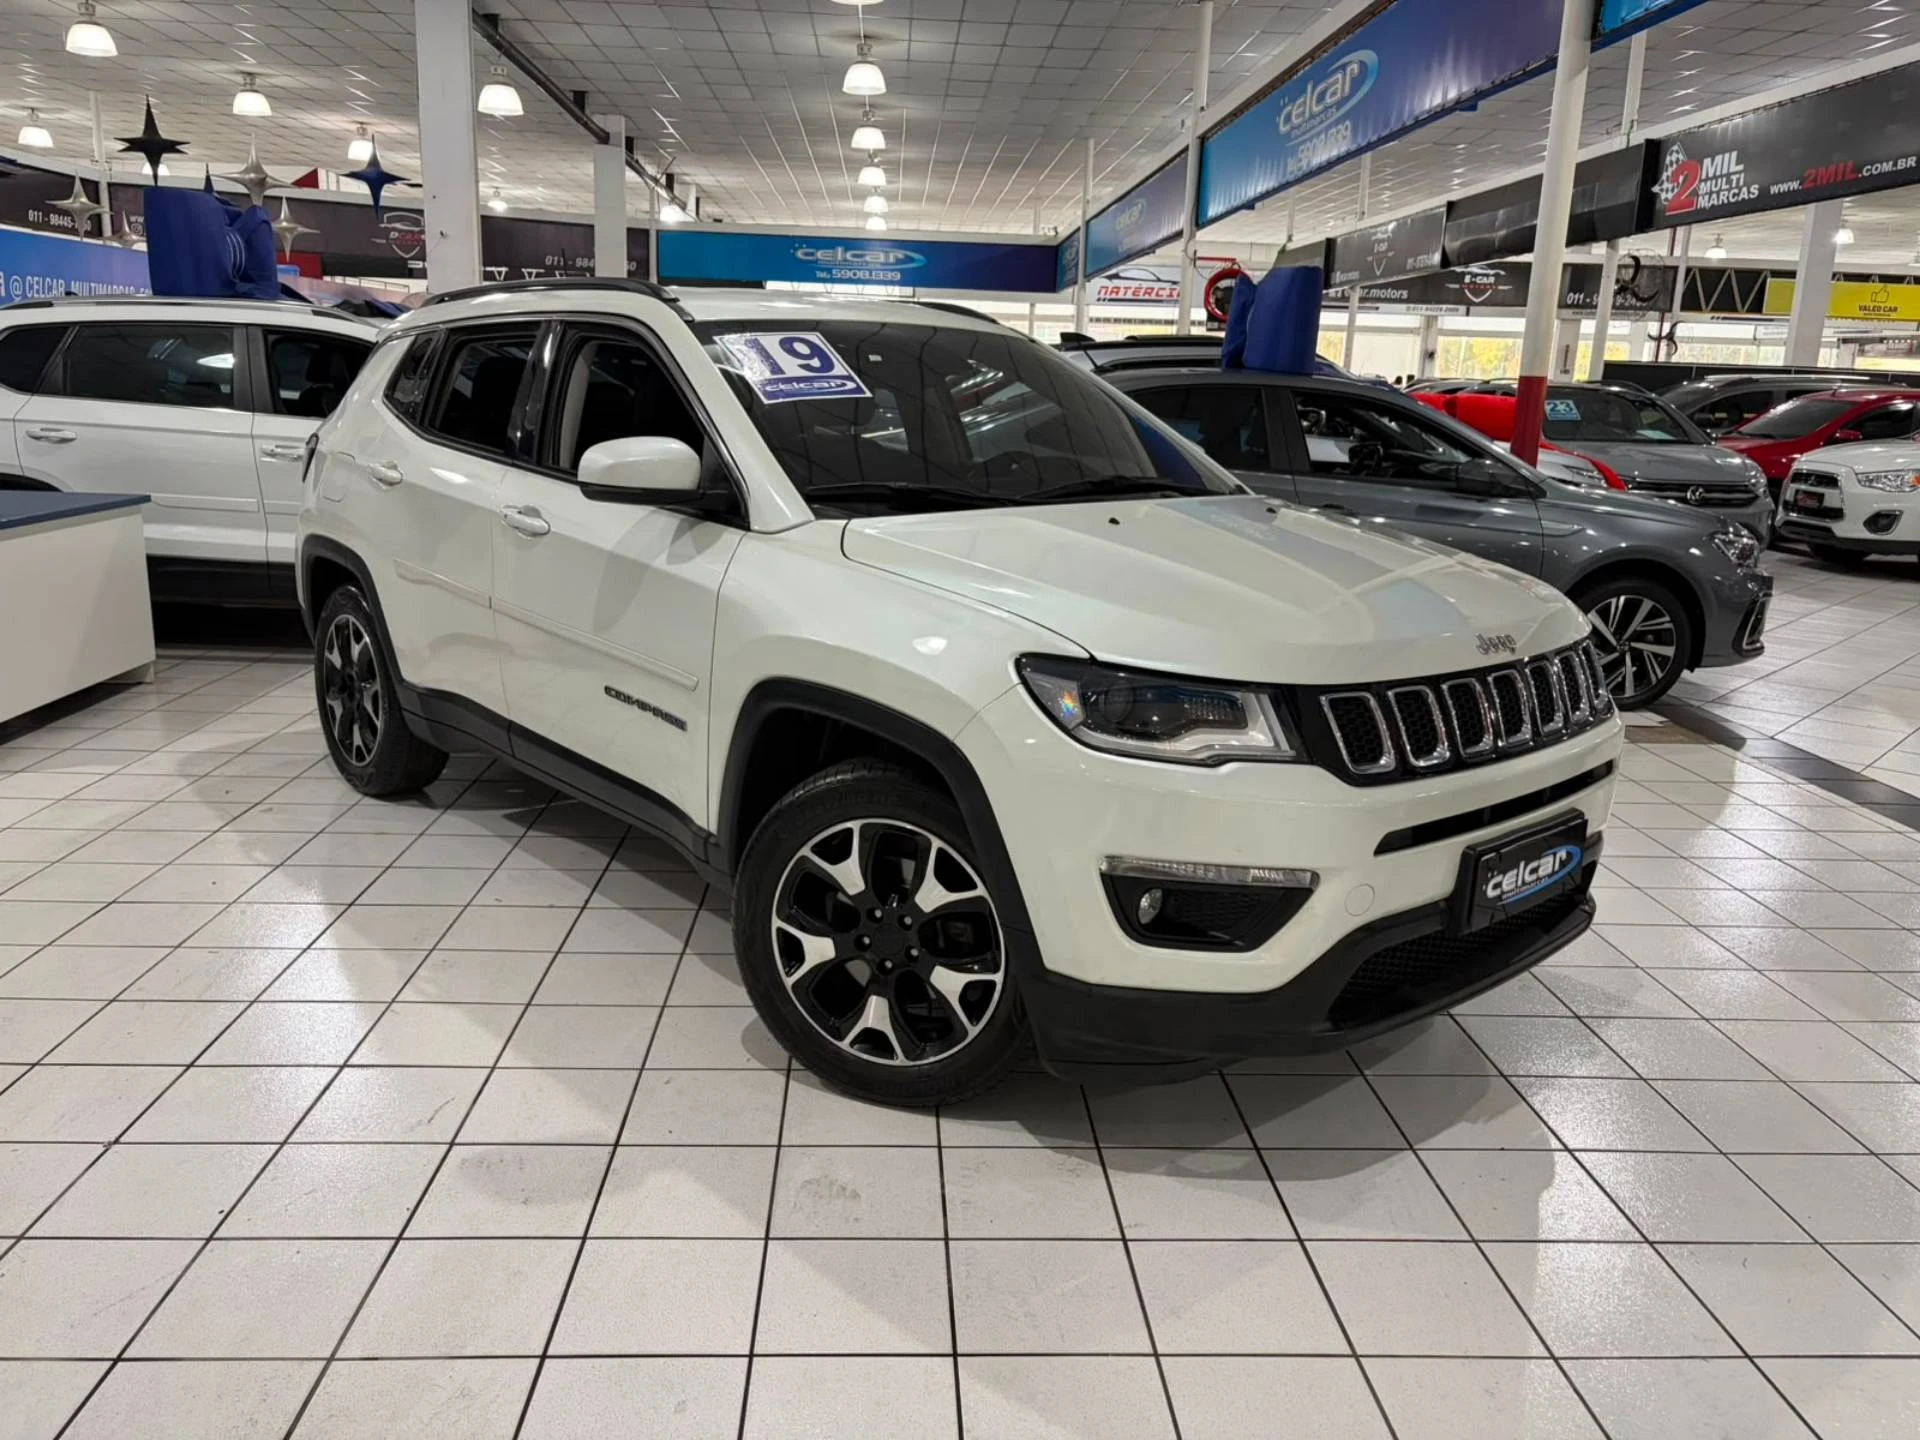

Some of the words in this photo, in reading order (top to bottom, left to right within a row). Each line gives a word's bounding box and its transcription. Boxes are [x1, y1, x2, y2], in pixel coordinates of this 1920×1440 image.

[1279, 62, 1360, 134] celcar
[1665, 160, 1700, 215] 2
[1701, 151, 1744, 180] MIL
[1699, 173, 1744, 195] MULTI
[1697, 184, 1759, 209] MARCAS
[29, 210, 42, 223] 011
[545, 256, 564, 267] 011
[796, 247, 905, 264] celcar
[26, 275, 65, 298] CELCAR
[1098, 283, 1181, 298] NATÉRCI
[1566, 292, 1584, 304] 011
[744, 336, 835, 375] 19
[765, 380, 842, 392] celcar
[1476, 633, 1517, 656] Jeep
[1486, 849, 1567, 898] celcar
